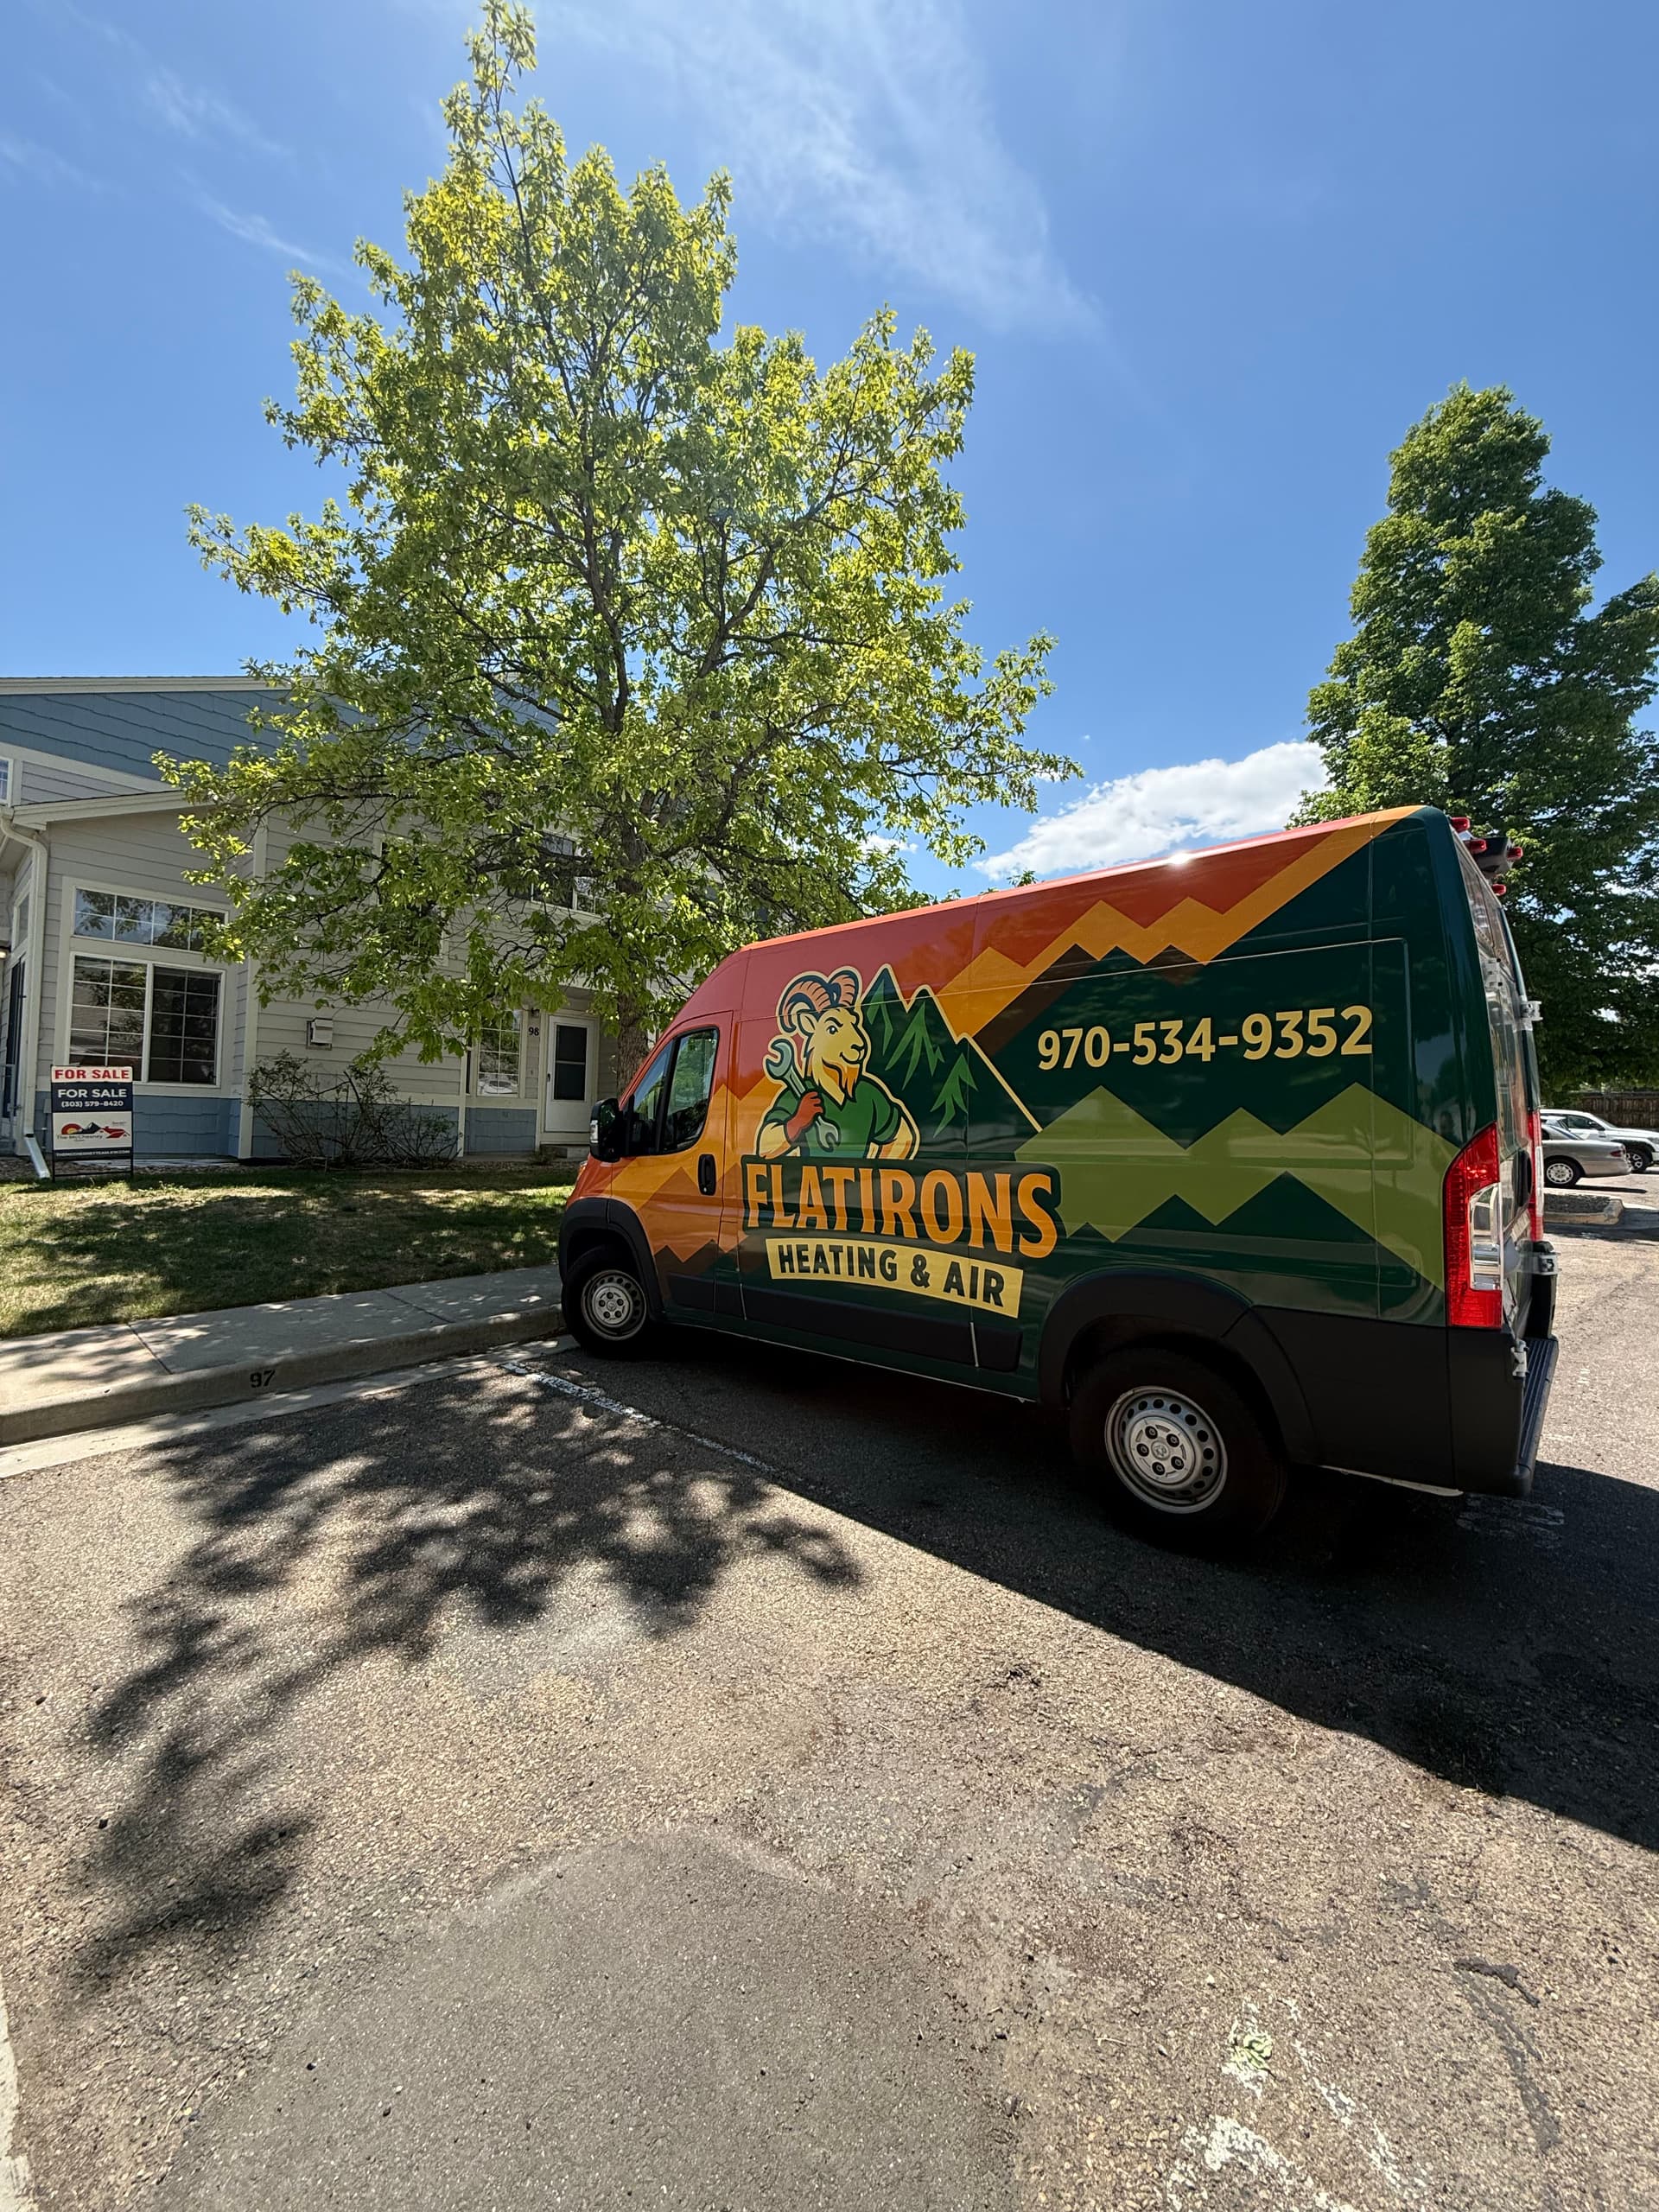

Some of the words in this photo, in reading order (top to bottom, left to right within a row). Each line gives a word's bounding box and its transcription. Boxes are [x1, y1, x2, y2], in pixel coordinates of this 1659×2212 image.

[528, 1027, 540, 1036] 98
[1038, 1005, 1372, 1071] 970-534-9352
[54, 1069, 86, 1079] FOR
[92, 1070, 130, 1079] SALE
[57, 1089, 87, 1098] FOR
[92, 1089, 127, 1097] SALE
[747, 1163, 1058, 1258] FLATIRONS
[778, 1244, 898, 1282] HEATING
[910, 1254, 931, 1288] &
[943, 1262, 1004, 1308] AIR
[250, 1370, 276, 1389] 97
